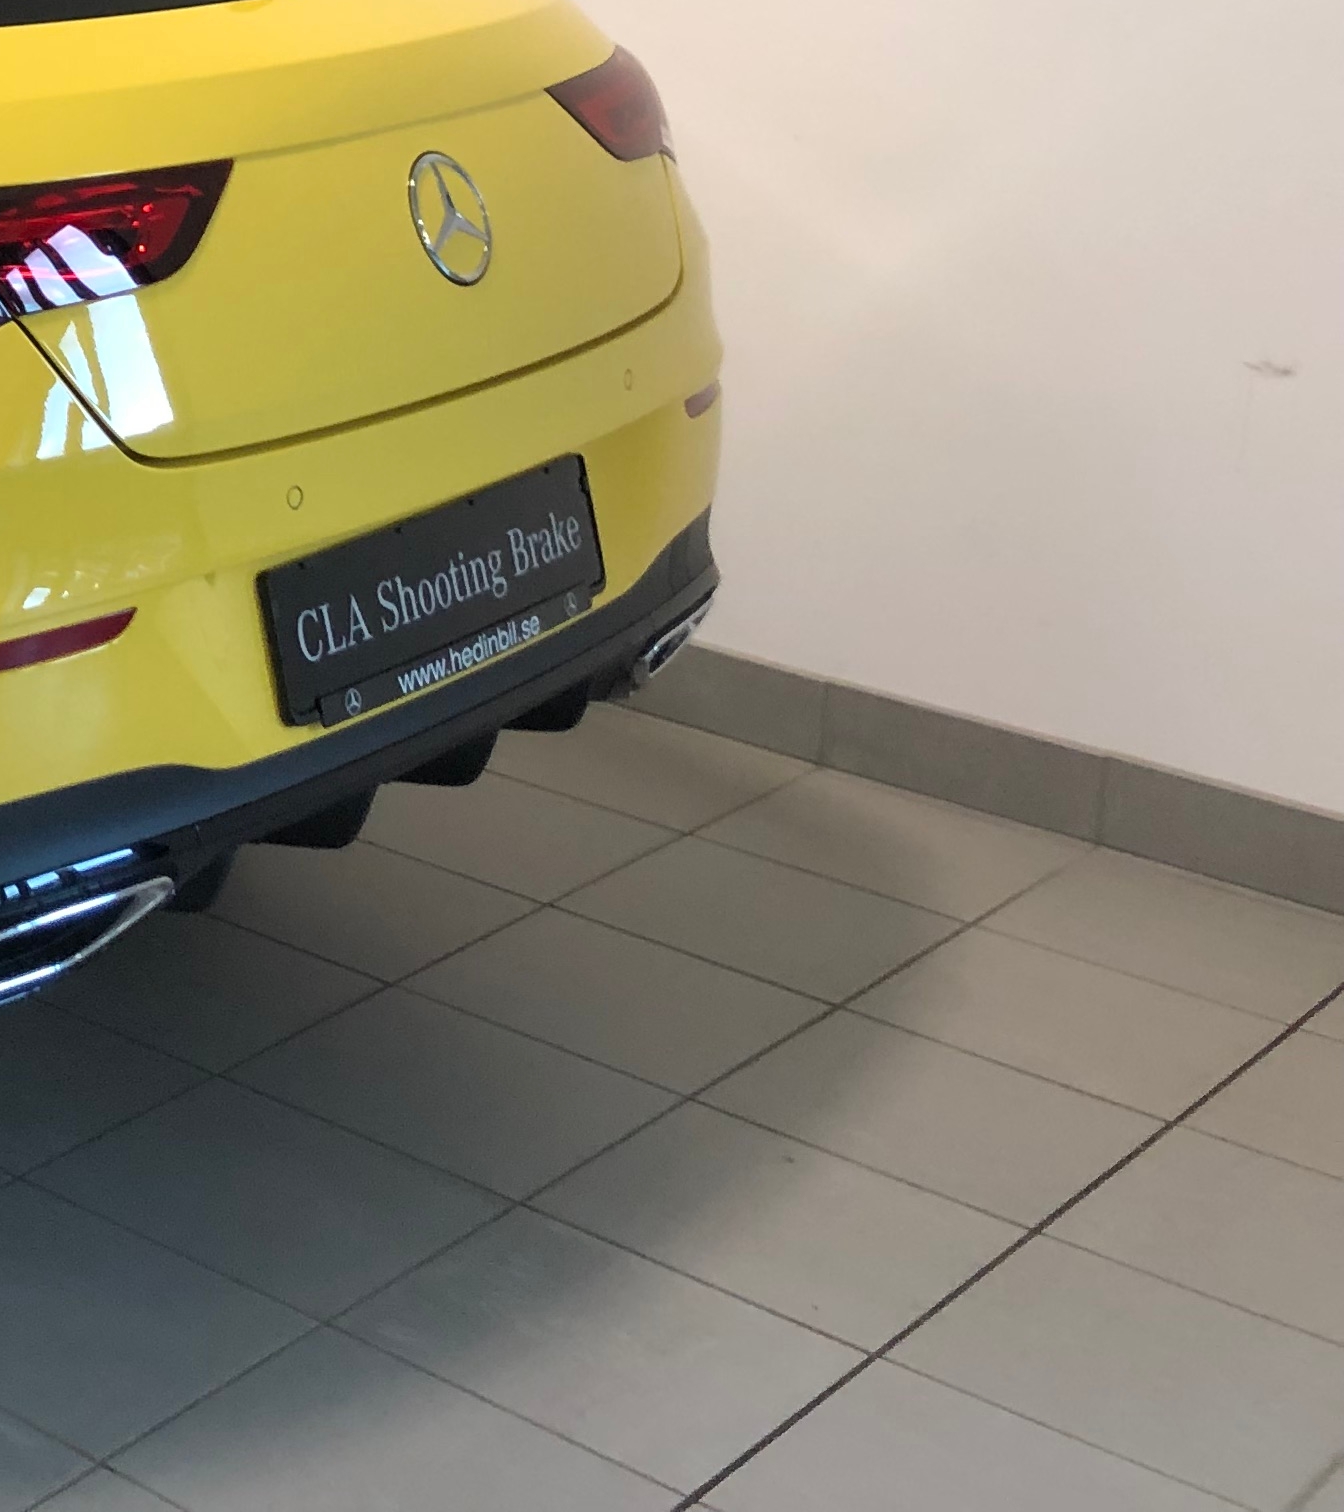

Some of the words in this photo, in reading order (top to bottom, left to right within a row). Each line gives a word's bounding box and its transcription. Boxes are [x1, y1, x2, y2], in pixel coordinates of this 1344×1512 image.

[297, 594, 373, 663] CLA
[377, 552, 508, 632] Shooting
[507, 512, 582, 577] Brake
[398, 614, 541, 694] www.hedinbil.se
